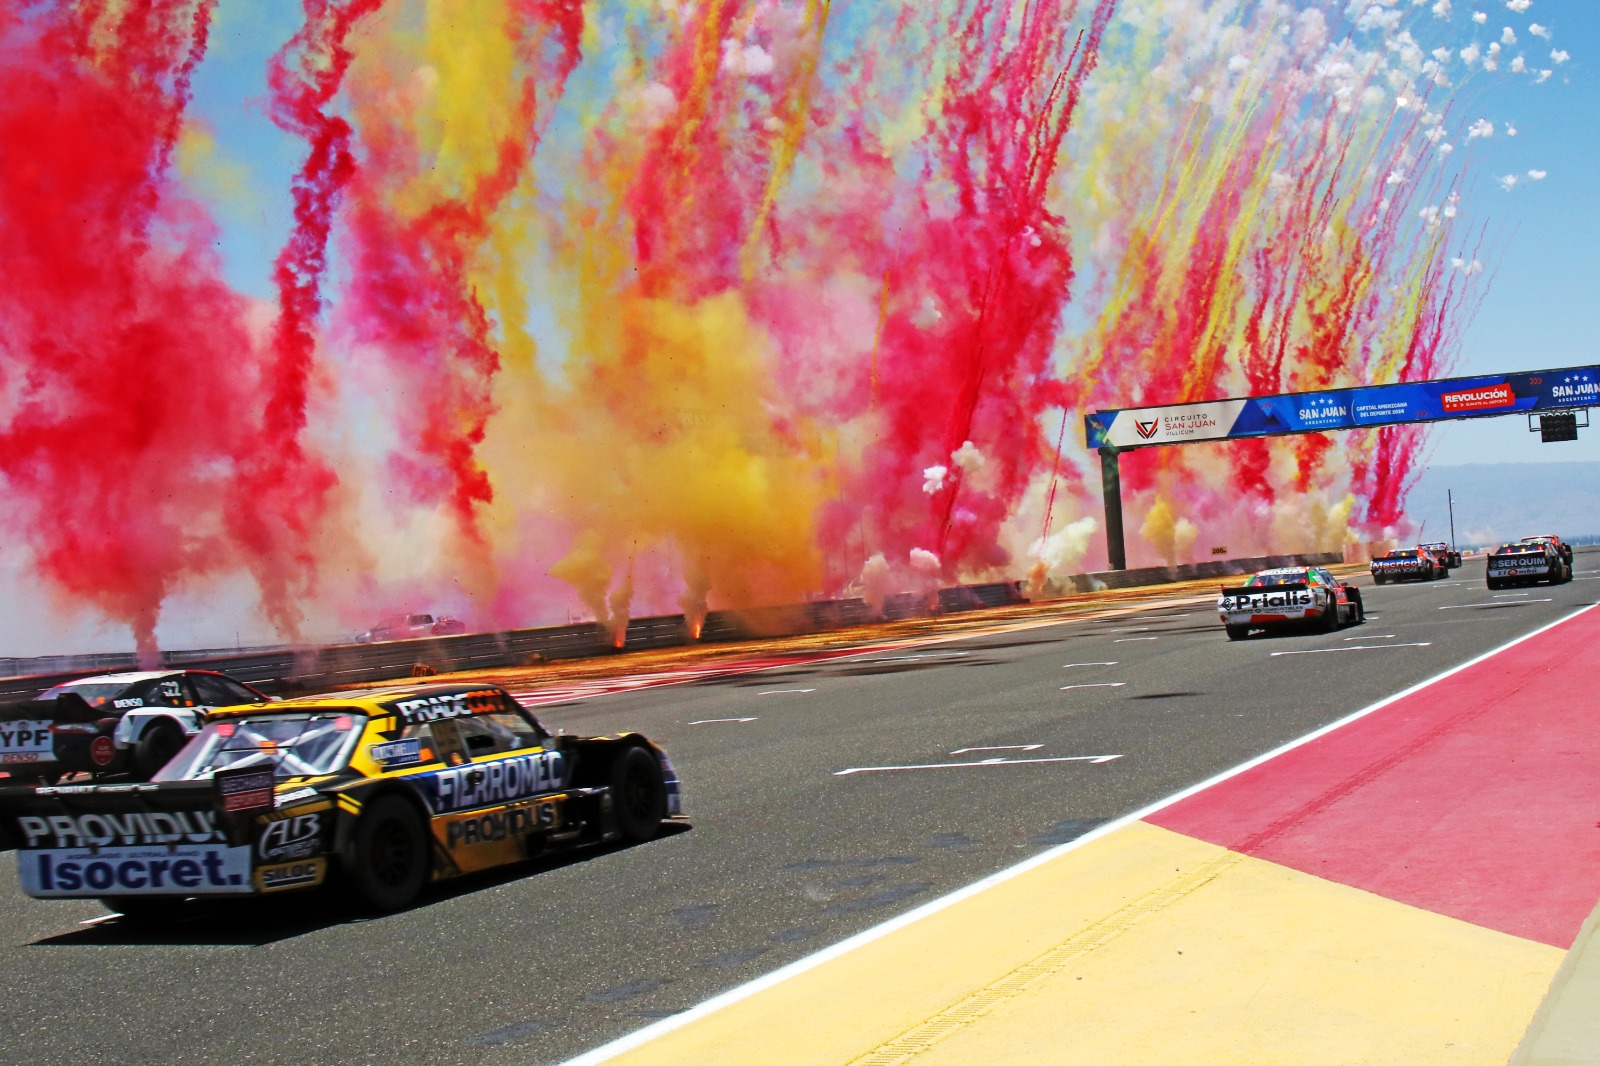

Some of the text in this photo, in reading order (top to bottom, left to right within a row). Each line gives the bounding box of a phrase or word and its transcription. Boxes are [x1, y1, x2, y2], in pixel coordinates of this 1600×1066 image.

[1444, 388, 1508, 403] REVOLUCIÓN
[1552, 382, 1600, 398] SAN JUAN
[1377, 402, 1408, 410] AMERICANA
[1164, 413, 1208, 423] CIRCUITO
[1299, 406, 1347, 421] SAN JUAN
[1165, 419, 1216, 431] SAN JUAN
[1372, 559, 1418, 569] Macrico
[1498, 557, 1546, 568] SER QUIM
[1236, 591, 1311, 610] Prialis
[113, 697, 144, 709] DENSO
[0, 729, 49, 748] YPF
[2, 752, 39, 763] DENSO
[447, 802, 554, 850] PROVIDUS
[38, 850, 242, 890] Isocret.
